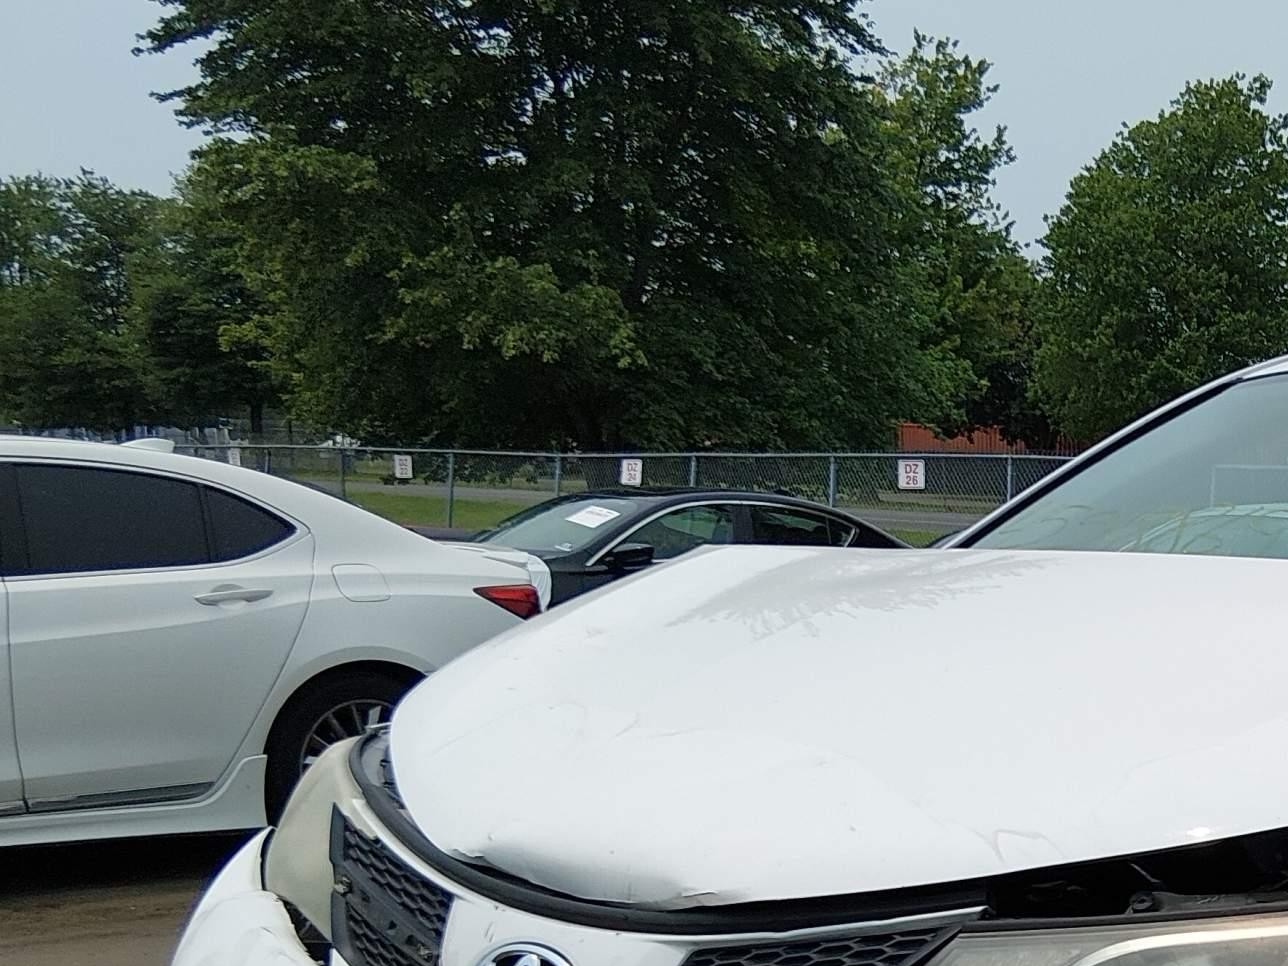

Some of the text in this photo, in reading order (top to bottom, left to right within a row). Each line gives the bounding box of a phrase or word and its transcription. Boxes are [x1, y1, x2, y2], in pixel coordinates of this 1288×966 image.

[627, 462, 638, 472] DZ
[904, 463, 919, 474] DZ
[905, 475, 918, 485] 26
